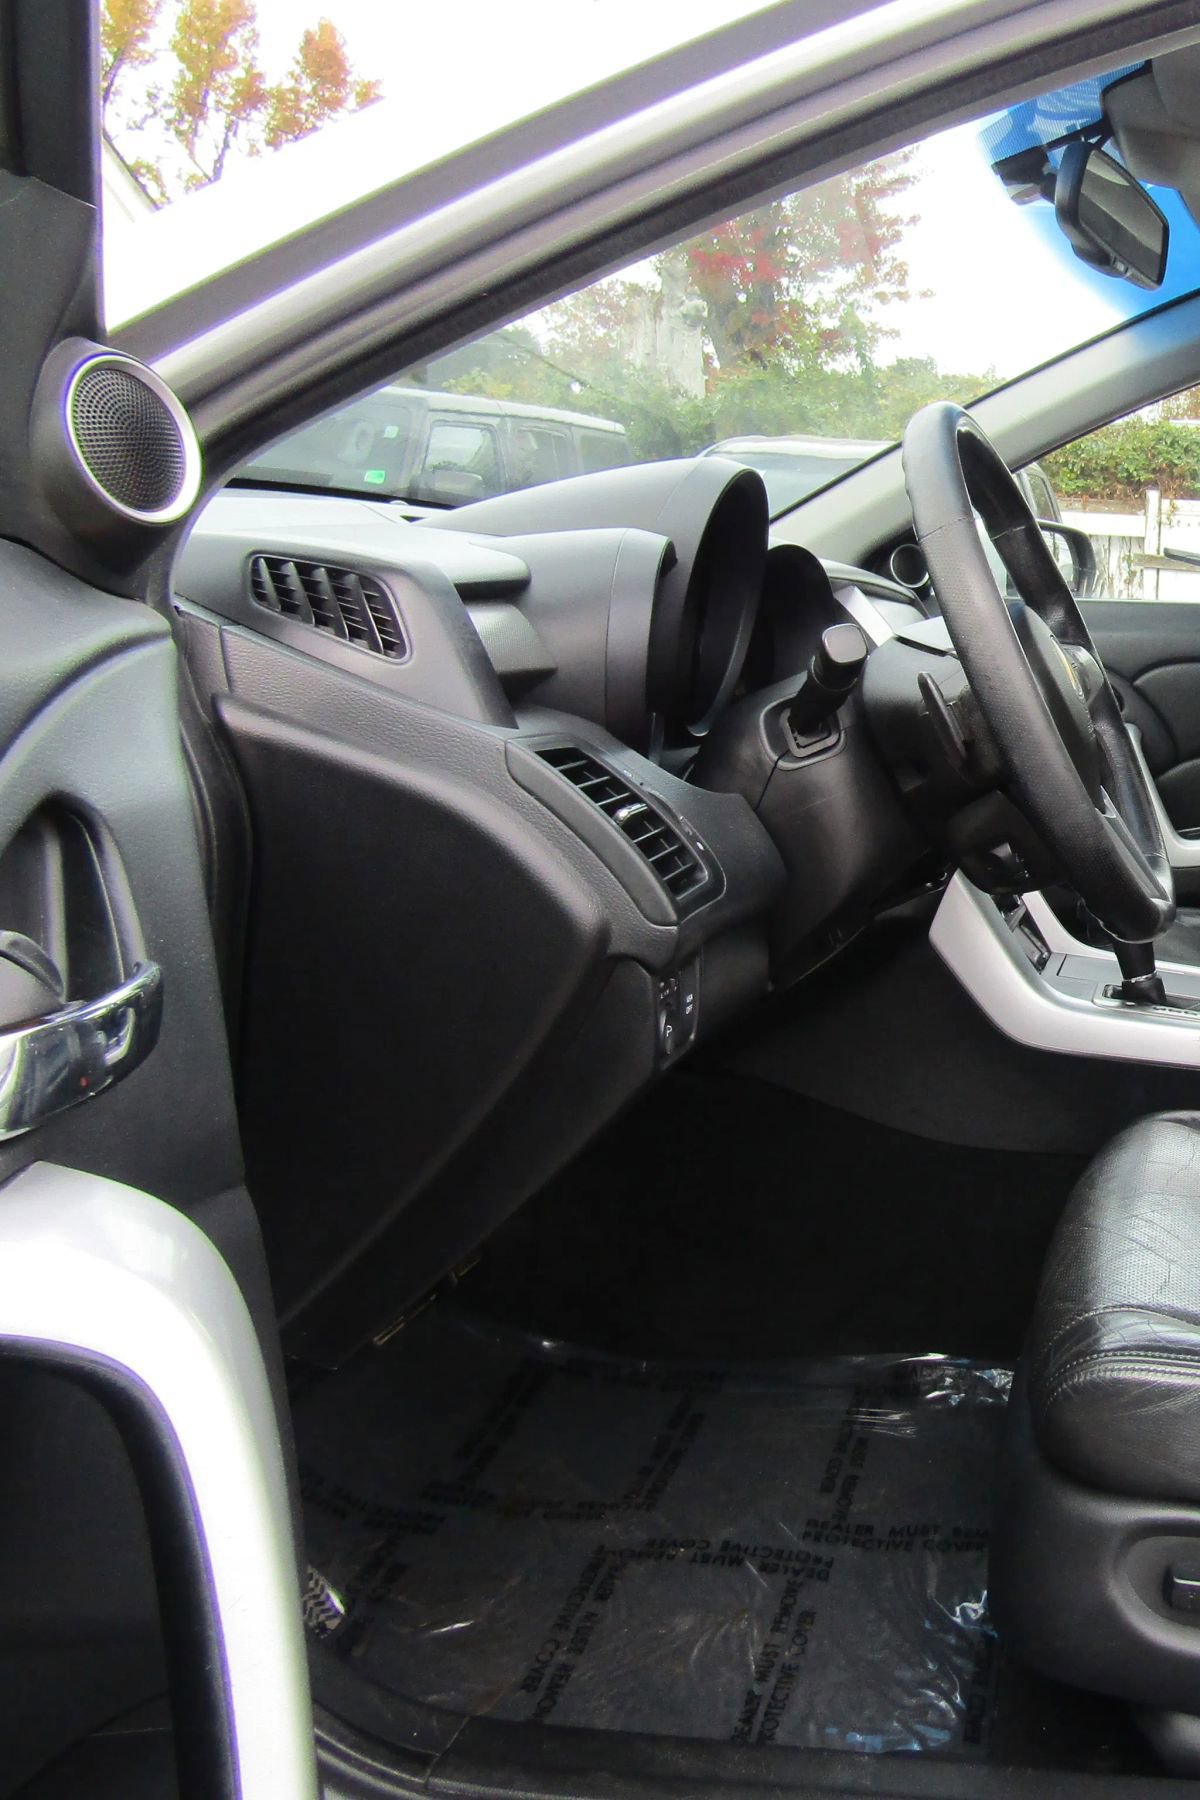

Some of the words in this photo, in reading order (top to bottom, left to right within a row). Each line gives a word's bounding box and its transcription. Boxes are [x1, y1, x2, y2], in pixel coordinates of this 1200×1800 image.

[666, 1024, 672, 1037] P
[805, 1517, 873, 1535] DEALER
[888, 1521, 939, 1539] MUST
[645, 1533, 710, 1553] COVER
[718, 1539, 834, 1567] PROTECTIVE
[801, 1530, 913, 1552] PROTECTIVE
[922, 1537, 991, 1555] COVER
[689, 1550, 744, 1568] MUST
[757, 1561, 829, 1582] DEALER
